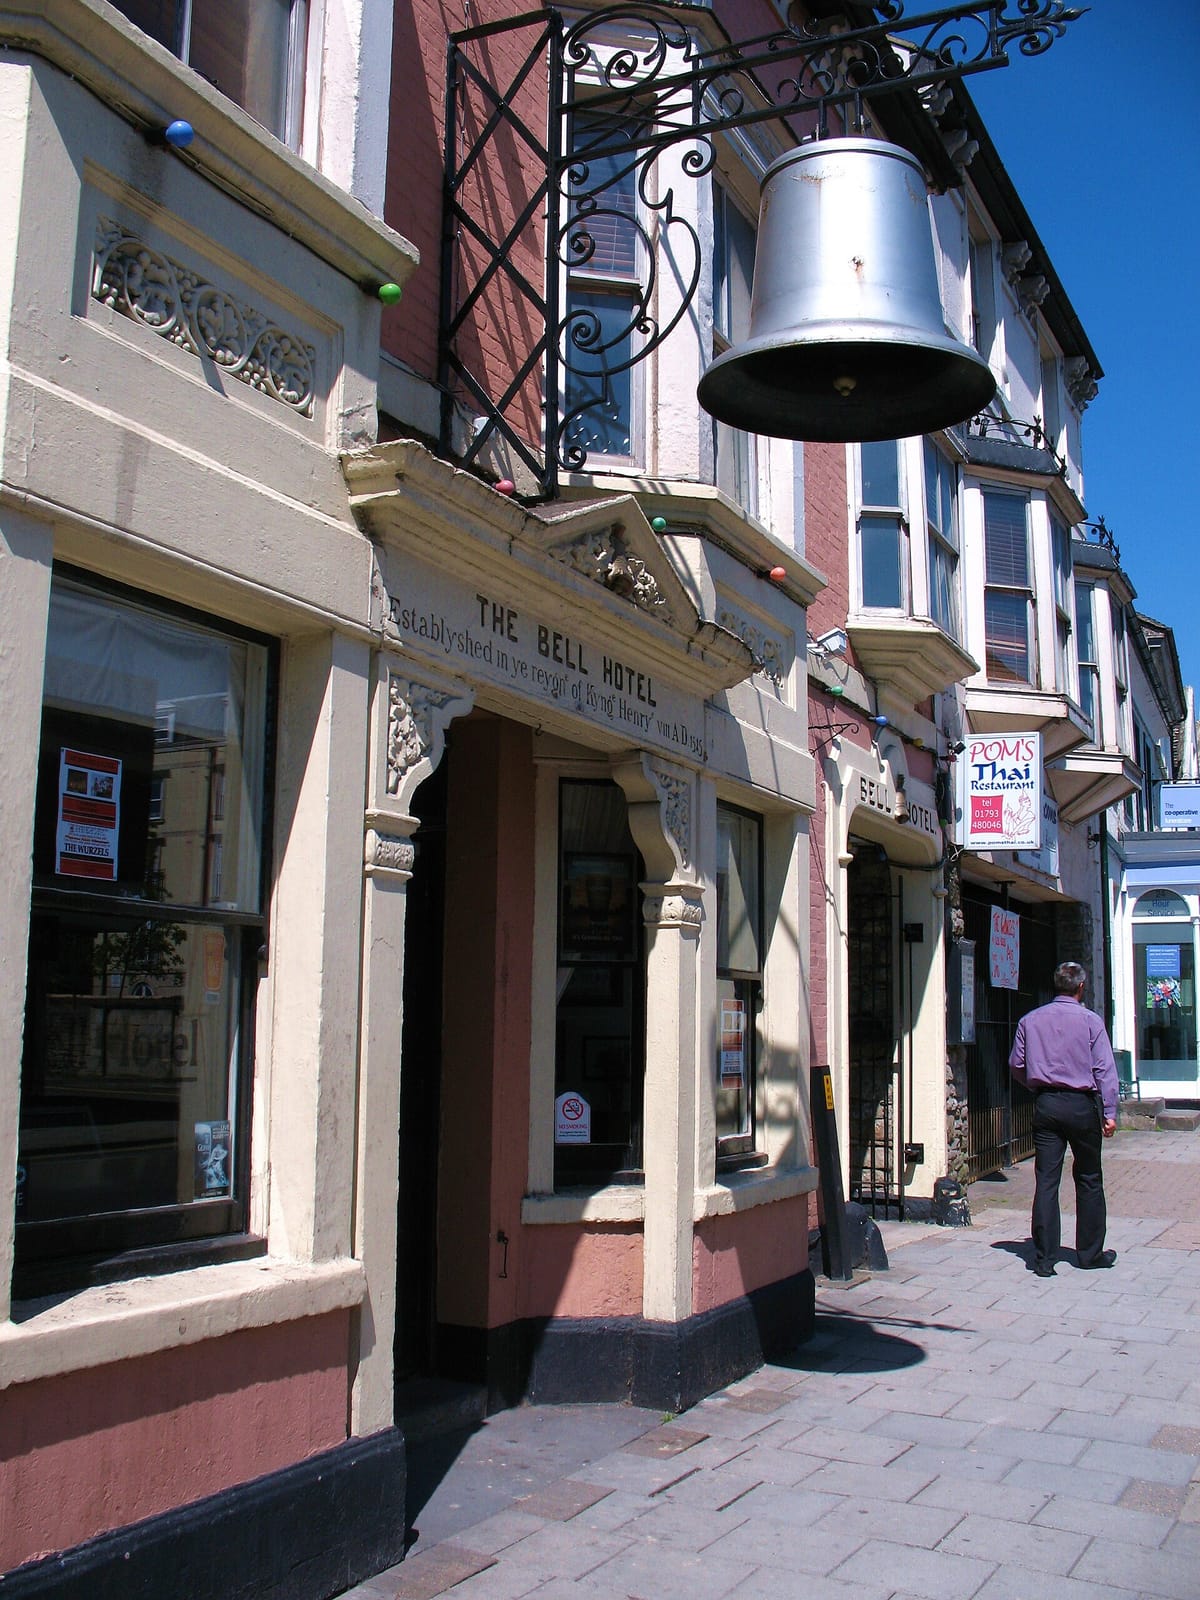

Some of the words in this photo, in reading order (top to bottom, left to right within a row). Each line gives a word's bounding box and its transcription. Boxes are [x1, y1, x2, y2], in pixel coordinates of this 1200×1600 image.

[388, 594, 494, 662] Establyshed
[496, 647, 509, 669] in
[512, 655, 528, 680] ye
[571, 677, 584, 700] of
[476, 593, 519, 643] THE
[537, 623, 588, 676] BELL
[602, 655, 657, 708] HOTEL
[969, 738, 1035, 763] POM'S
[971, 761, 1031, 781] Thai
[860, 776, 891, 813] BELL
[970, 780, 1034, 791] Restaurant
[974, 809, 999, 818] 01793
[972, 820, 1002, 829] 480046
[64, 842, 77, 853] THE
[78, 844, 110, 857] WURZELS
